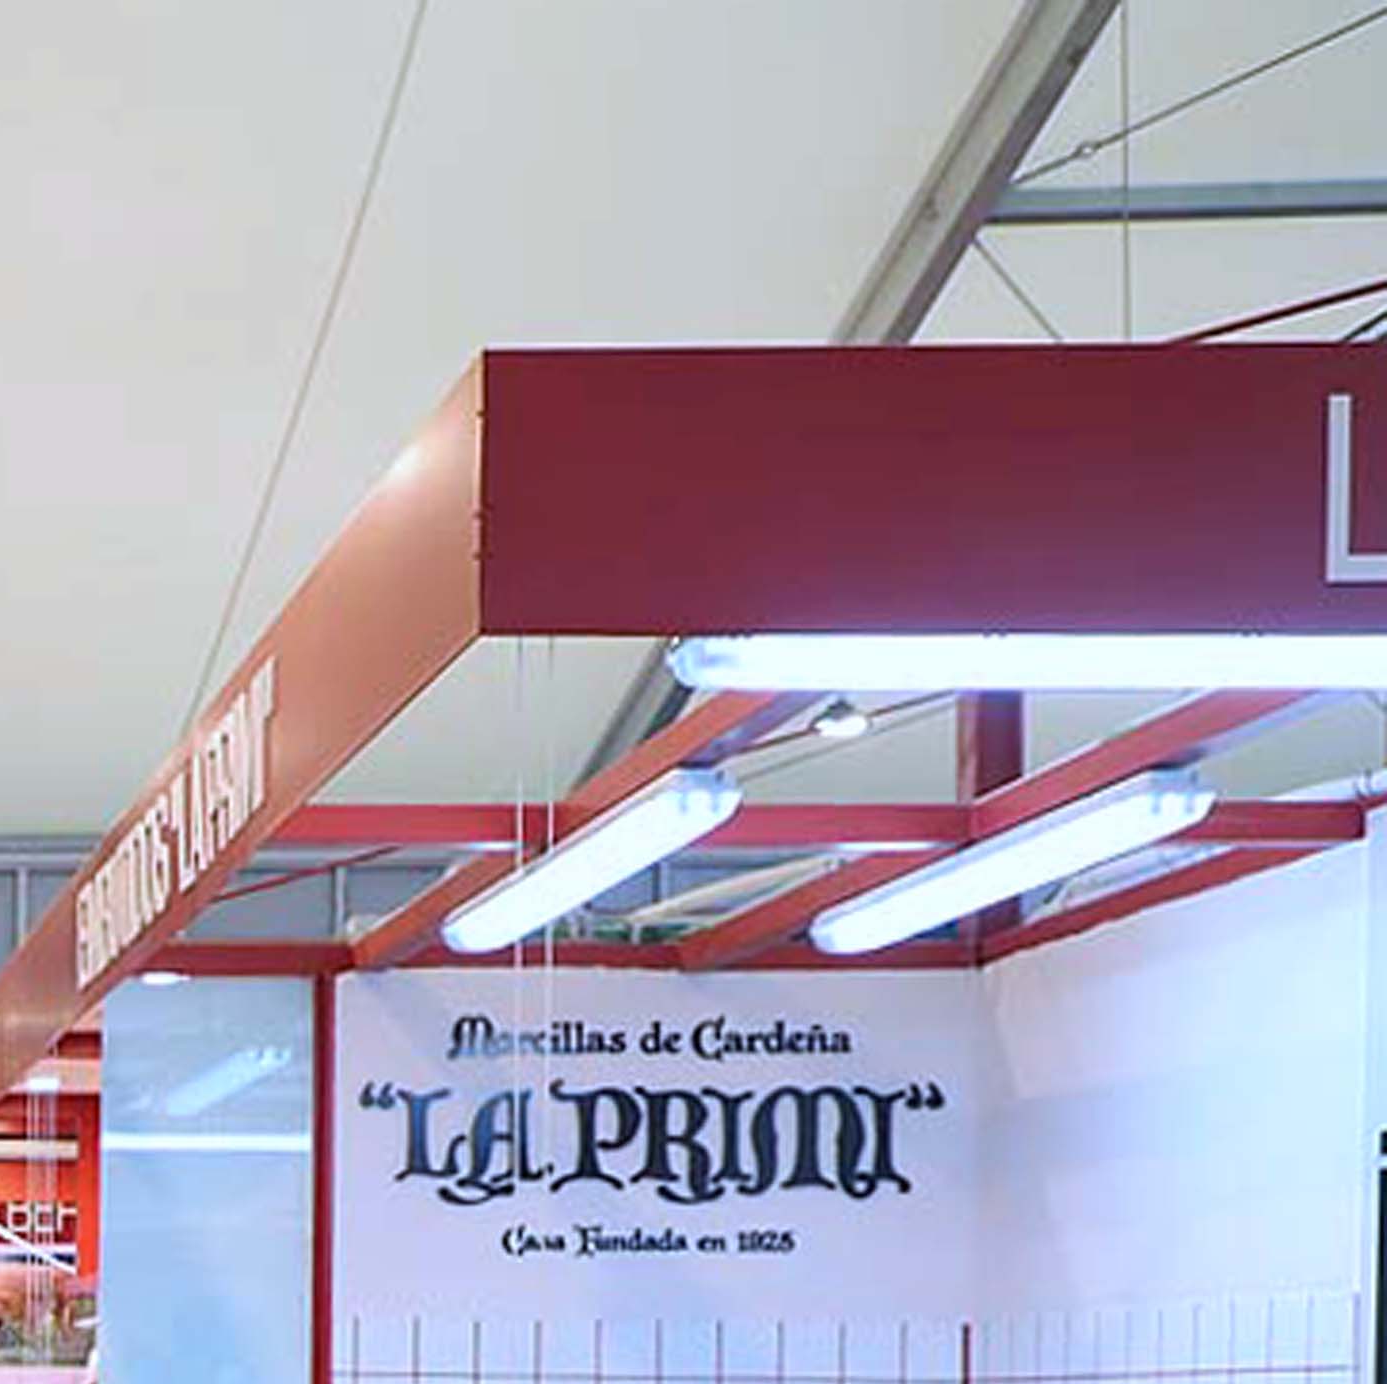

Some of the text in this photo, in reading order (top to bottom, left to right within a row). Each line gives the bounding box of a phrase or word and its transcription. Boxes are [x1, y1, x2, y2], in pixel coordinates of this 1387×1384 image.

[639, 1021, 682, 1055] de
[690, 1014, 852, 1062] Cardeña
[573, 1224, 688, 1257] Fundada
[696, 1233, 726, 1253] en
